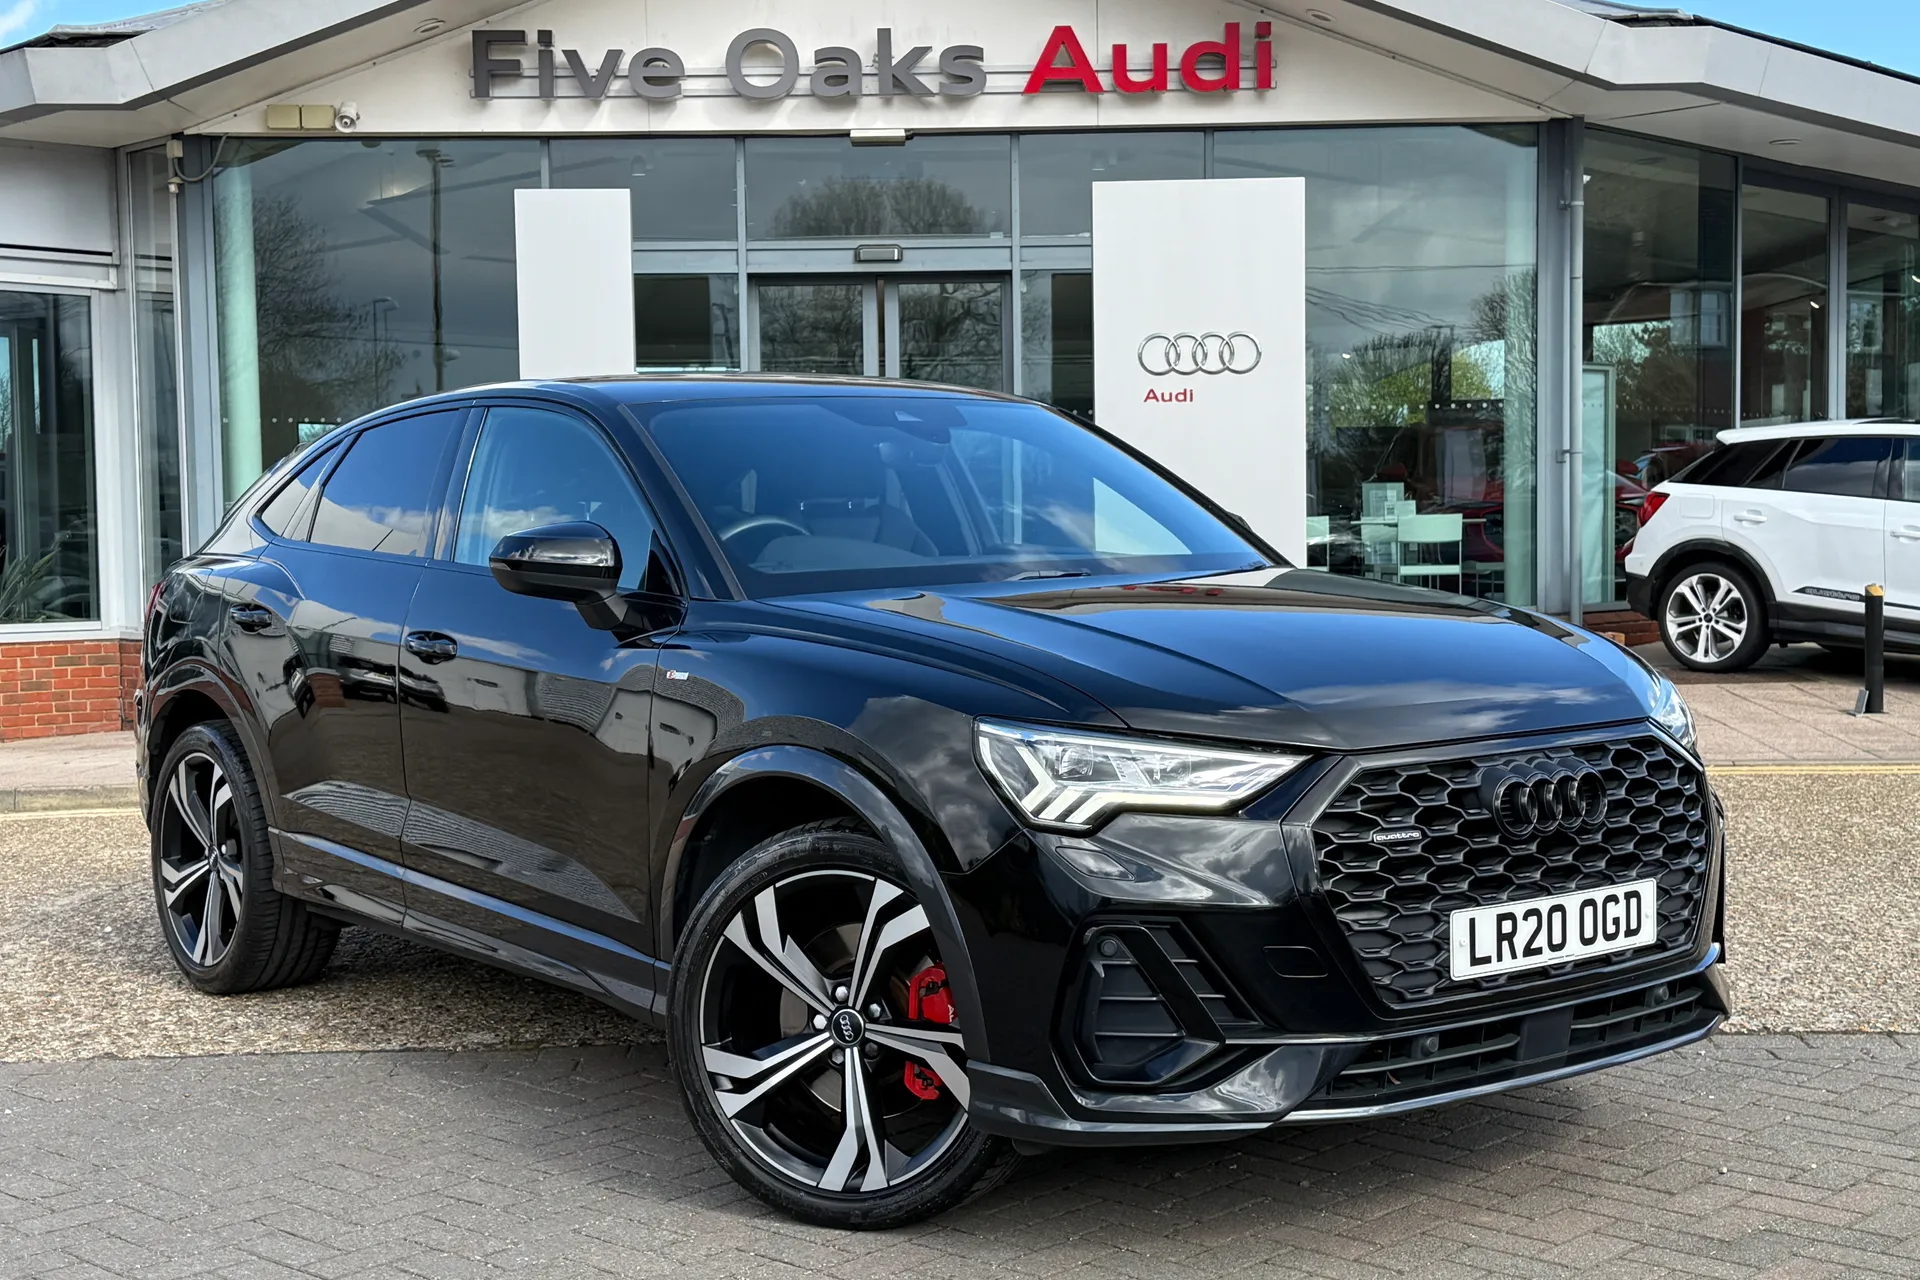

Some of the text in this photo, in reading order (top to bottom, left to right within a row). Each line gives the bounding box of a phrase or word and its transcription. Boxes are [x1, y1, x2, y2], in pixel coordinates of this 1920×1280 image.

[472, 21, 1272, 100] Five Oaks Audi
[1143, 388, 1194, 403] Audi
[1376, 832, 1420, 841] quattro
[1469, 889, 1643, 967] LR20 OGD
